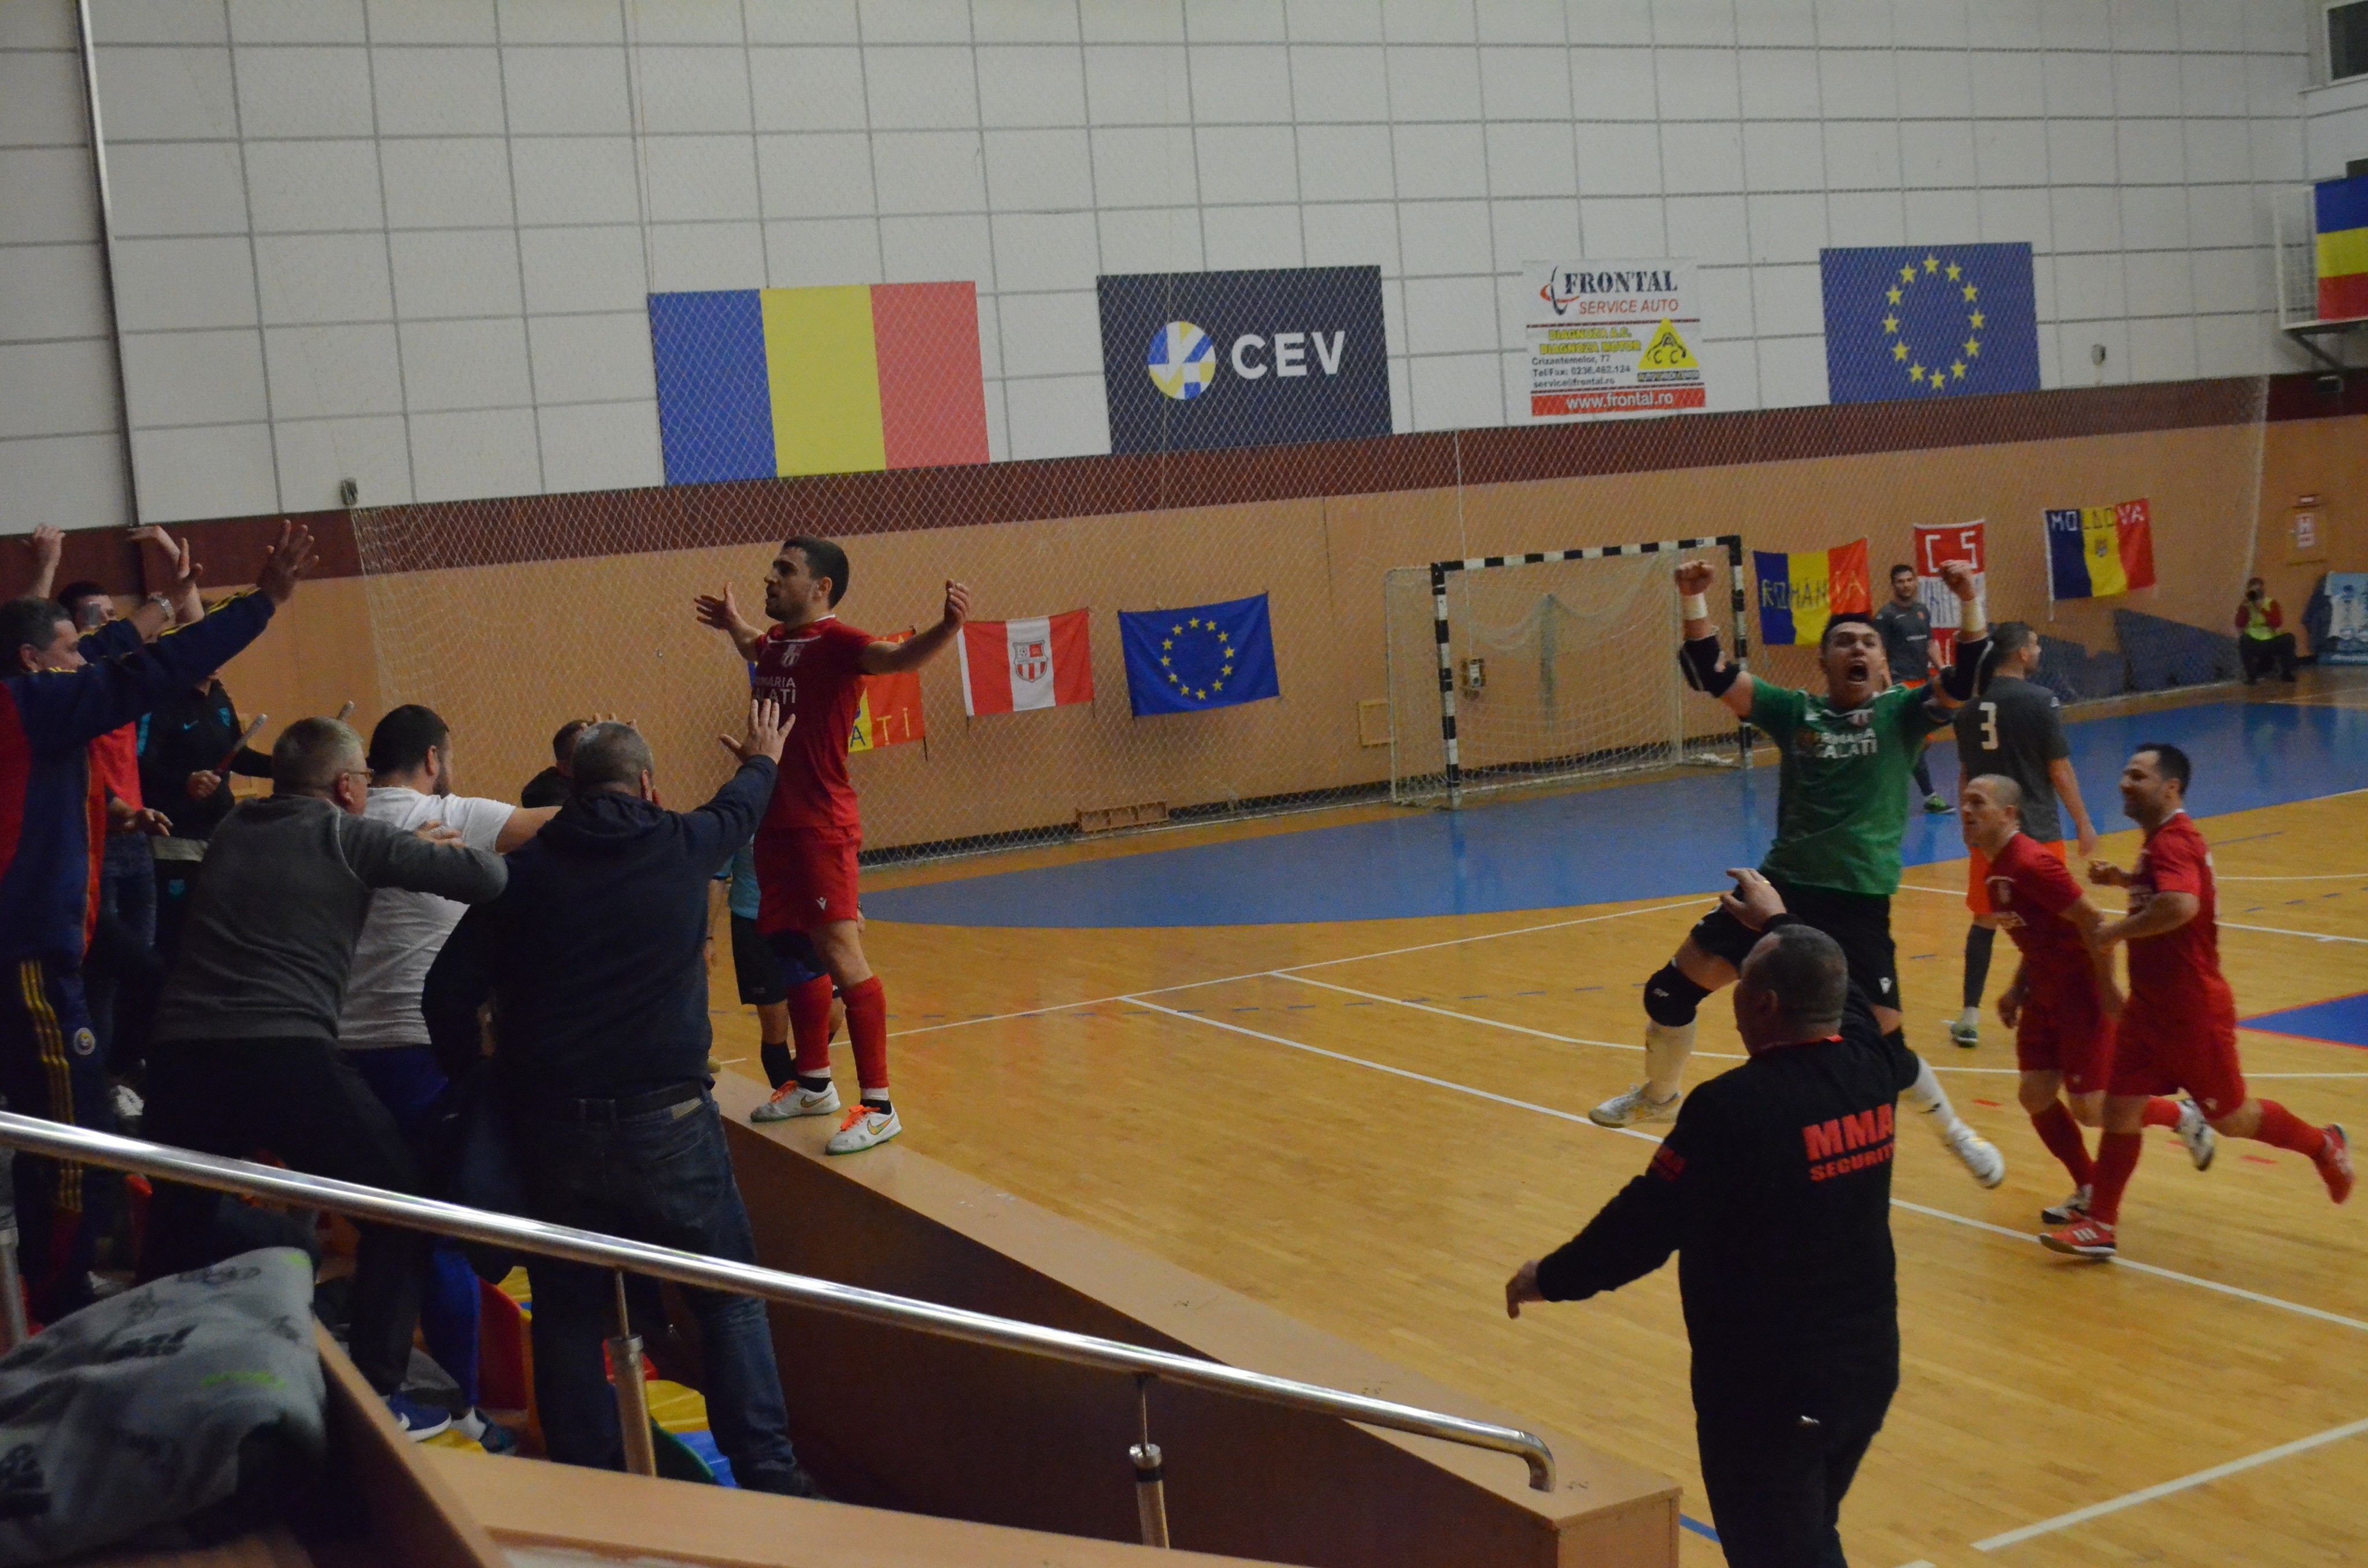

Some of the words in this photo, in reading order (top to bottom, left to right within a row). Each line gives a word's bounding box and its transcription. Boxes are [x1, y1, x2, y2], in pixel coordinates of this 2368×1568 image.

[1563, 270, 1678, 295] FRONTAL
[1579, 299, 1637, 315] SERVICE
[1641, 298, 1679, 313] AUTO
[1549, 328, 1608, 341] DIAGNOZA
[1231, 331, 1345, 379] CEV
[1539, 342, 1599, 355] DIAGNOZA
[1601, 341, 1641, 353] MOTOR
[1600, 354, 1611, 363] 77
[1566, 392, 1674, 410] www.frontal.ro
[2051, 505, 2145, 531] MOLDOVA
[1978, 702, 1999, 750] 3
[1803, 1103, 1895, 1162] MMA
